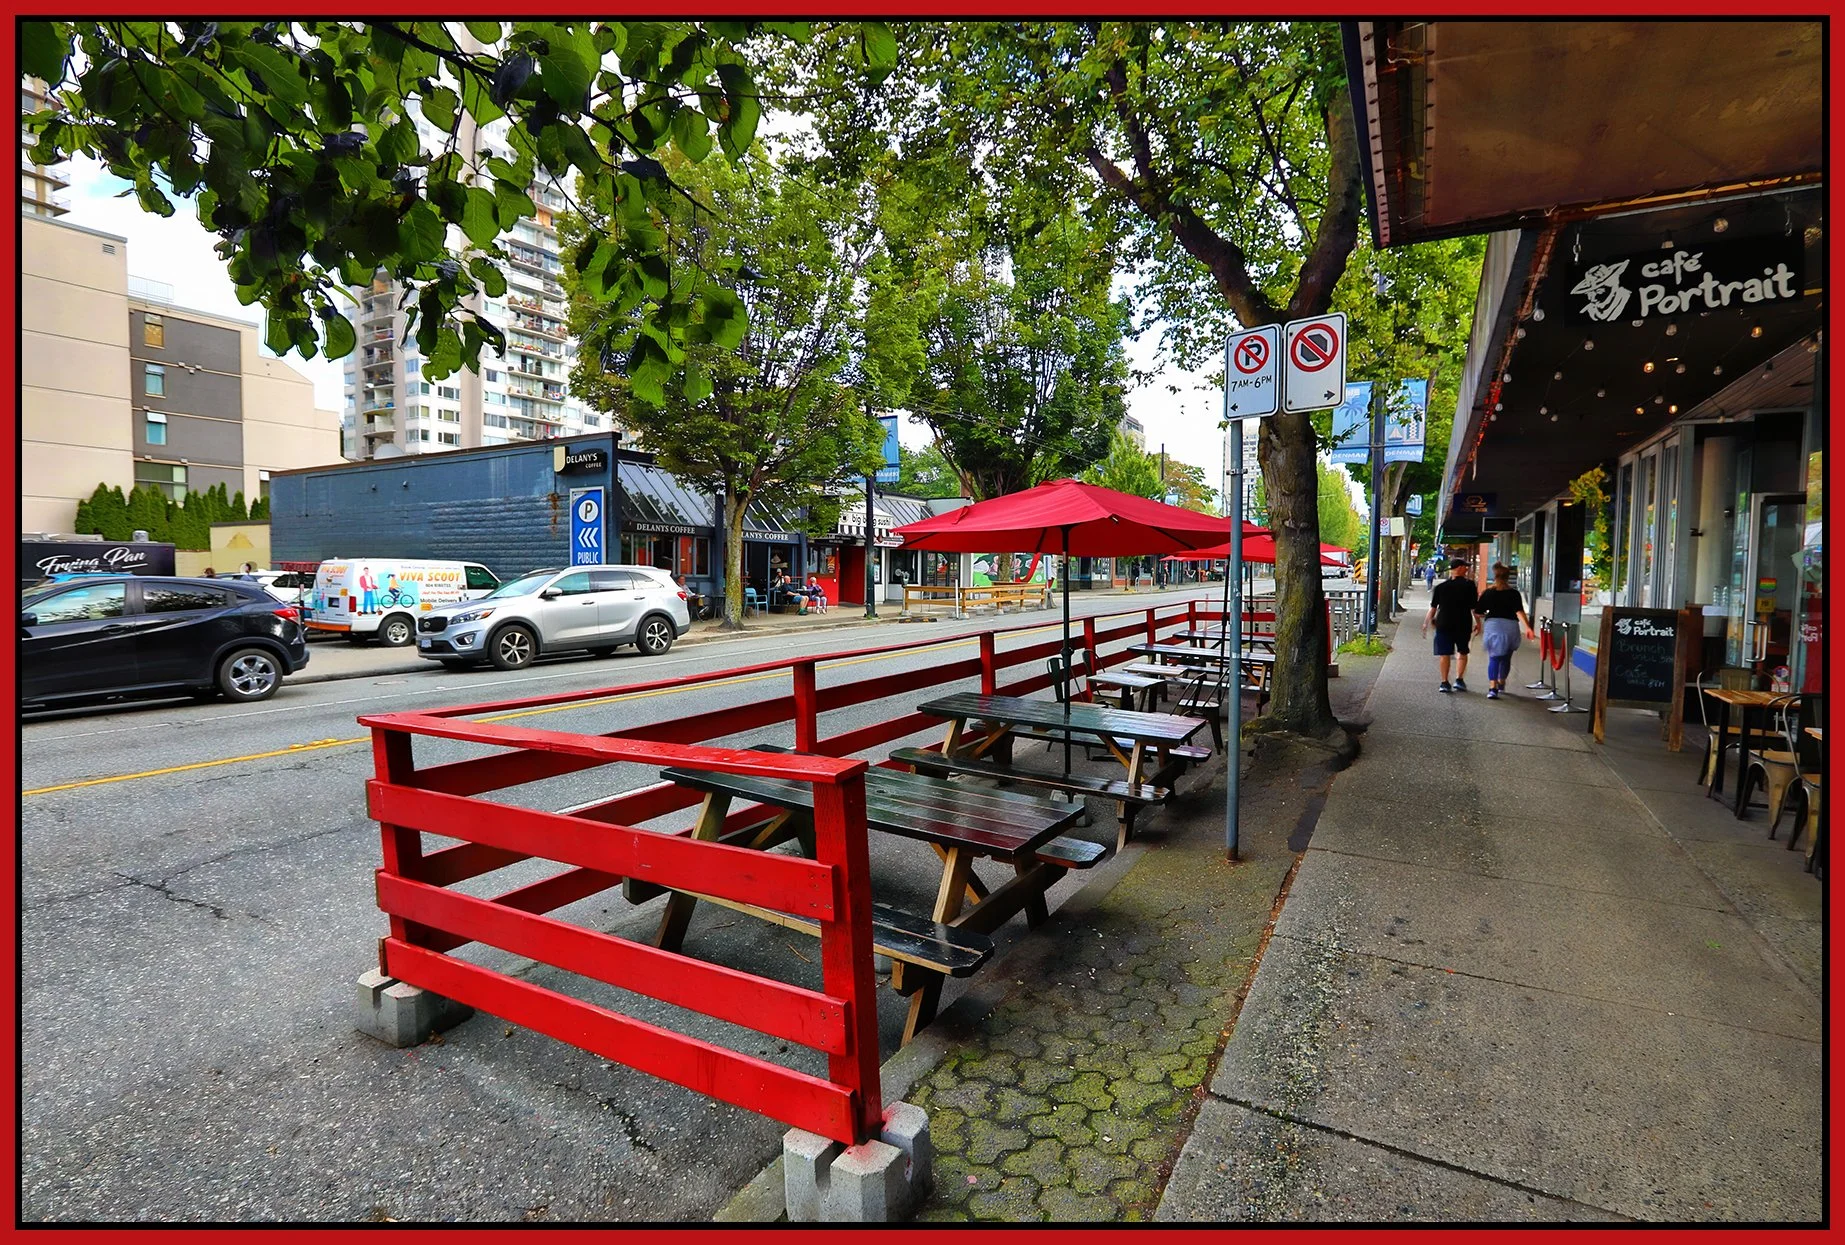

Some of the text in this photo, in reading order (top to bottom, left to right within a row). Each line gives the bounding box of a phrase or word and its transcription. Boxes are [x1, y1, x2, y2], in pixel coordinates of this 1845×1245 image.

[1641, 251, 1703, 285] café
[1639, 263, 1796, 317] Portrait
[566, 453, 597, 464] DELANY'S
[1385, 449, 1422, 457] DENMAN
[852, 514, 861, 526] big
[637, 523, 695, 534] DELANYS COFFEE
[764, 533, 789, 541] COFFEE
[103, 546, 145, 566] Pan
[577, 551, 598, 564] PUBLIC
[400, 571, 460, 582] VIVA SCOOT
[1633, 626, 1674, 636] Portrait
